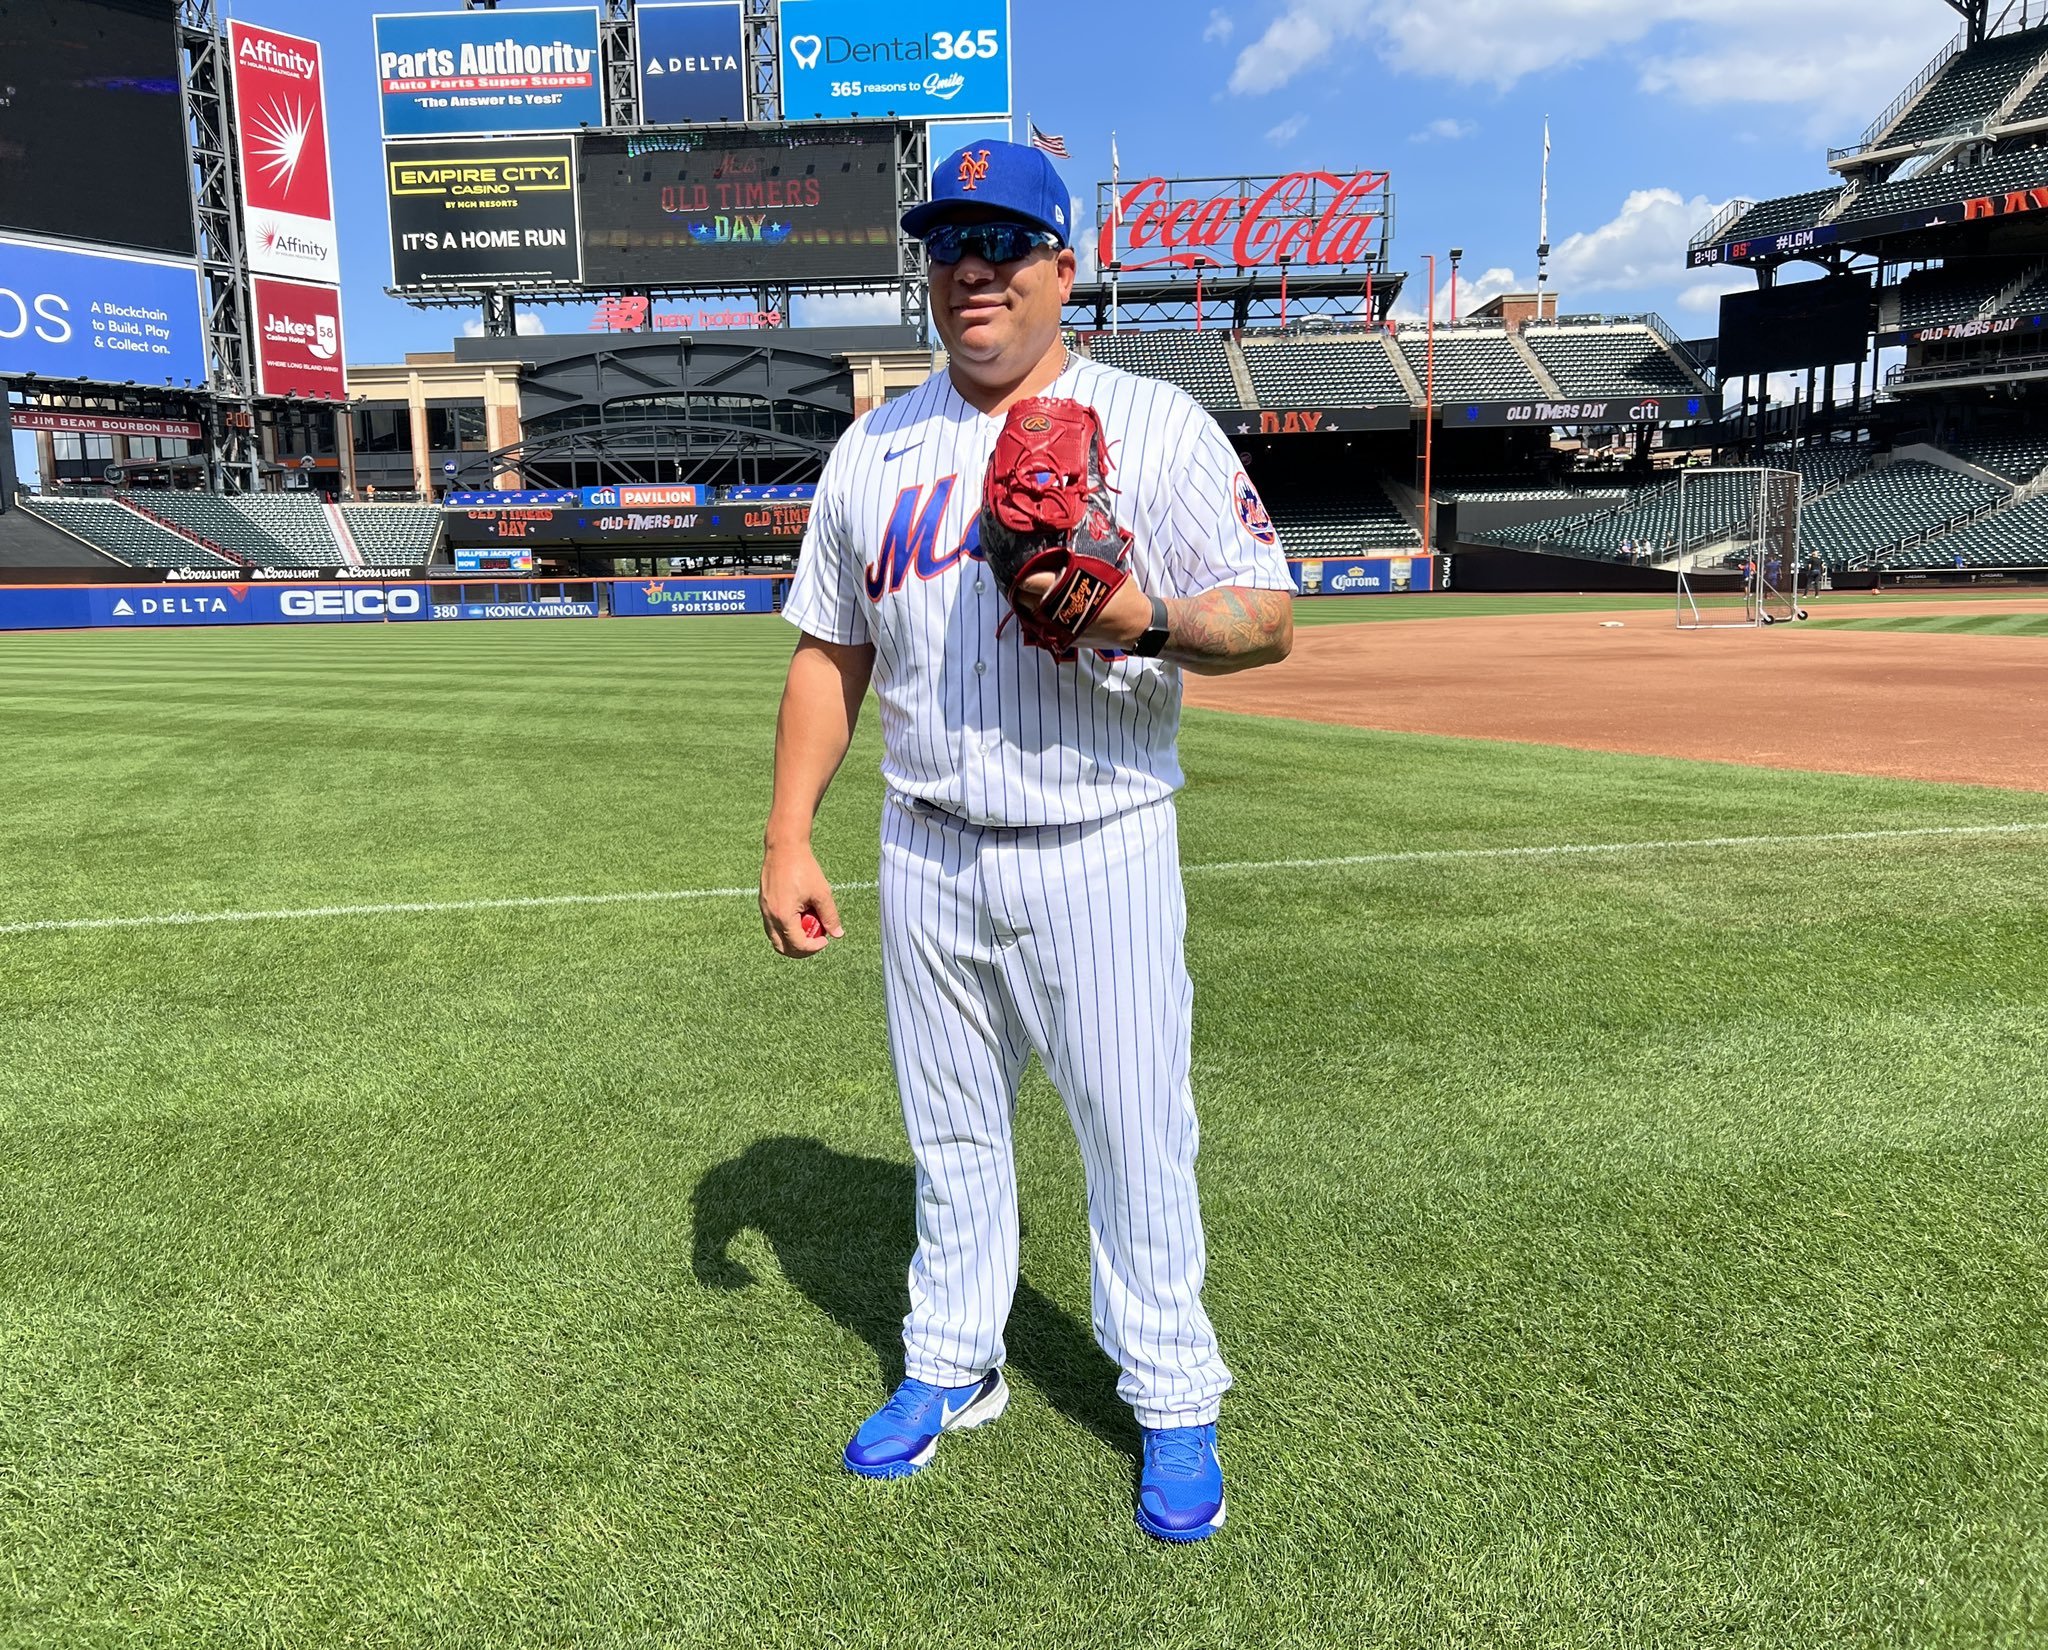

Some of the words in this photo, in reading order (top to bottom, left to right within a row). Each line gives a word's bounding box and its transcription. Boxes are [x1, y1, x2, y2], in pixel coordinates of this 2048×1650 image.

[826, 29, 999, 64] Dental365
[240, 37, 315, 79] Affinity
[381, 48, 454, 79] Parts
[460, 39, 591, 75] Authority
[669, 55, 737, 72] DELTA
[389, 81, 427, 91] Auto
[430, 79, 475, 89] Parts
[478, 77, 528, 87] Super
[531, 75, 586, 86] Stores
[830, 82, 862, 97] 365
[863, 83, 907, 94] reasons
[908, 82, 921, 92] to
[922, 72, 965, 100] Smile
[450, 96, 506, 107] Answer
[401, 169, 496, 185] EMPIRE
[451, 184, 510, 195] CASINO
[661, 186, 709, 212] OLD
[716, 178, 821, 210] TIMERS
[445, 201, 455, 209] BY
[457, 201, 477, 209] MGM
[479, 199, 518, 208] RESORTS
[714, 214, 766, 243] DAY
[275, 235, 328, 261] Affinity
[402, 232, 439, 250] IT'S
[443, 232, 457, 249] A
[460, 230, 520, 248] HOME
[525, 229, 566, 247] RUN
[1694, 248, 1718, 264] 2:48
[1776, 230, 1814, 250] #LGM
[91, 301, 101, 313] A
[104, 302, 168, 321] Blockchain
[655, 313, 693, 327] new
[699, 307, 781, 326] balance
[91, 318, 105, 331] to
[108, 320, 142, 337] Build,
[145, 323, 170, 340] Play
[264, 313, 315, 337] Jake's
[319, 326, 334, 338] 58
[1920, 328, 1944, 342] OLD
[1946, 321, 1991, 338] TIMERS
[1992, 317, 2019, 333] DAY
[94, 335, 105, 348] &
[107, 337, 149, 353] Collect
[151, 343, 171, 355] on.
[266, 333, 288, 343] Casino
[267, 360, 287, 368] WHERE
[1506, 407, 1532, 420] OLD
[1534, 403, 1579, 420] TIMERS
[1581, 402, 1608, 418] DAY
[1629, 400, 1659, 419] citi
[32, 416, 54, 426] JIM
[60, 418, 96, 428] BEAM
[102, 421, 160, 432] BOURBON
[166, 425, 190, 435] BAR
[1259, 411, 1323, 433] DAY
[590, 488, 616, 505] citi
[624, 491, 691, 504] PAVILION
[600, 517, 624, 531] OLD
[626, 513, 671, 530] TIMERS
[673, 514, 698, 529] DAY
[744, 511, 771, 527] OLD
[498, 521, 527, 537] DAY
[180, 567, 212, 580] Coors
[212, 571, 240, 580] LIGHT
[264, 567, 294, 580] Coors
[293, 570, 320, 579] LIGHT
[350, 566, 381, 579] Coors
[381, 569, 411, 578] LIGHT
[1331, 574, 1380, 591] Corona
[142, 598, 227, 614] DELTA
[280, 589, 420, 616] GEICO
[433, 605, 458, 618] 380
[485, 605, 536, 617] KONICA
[538, 604, 593, 616] MINOLTA
[671, 602, 746, 612] SPORTSBOOK
